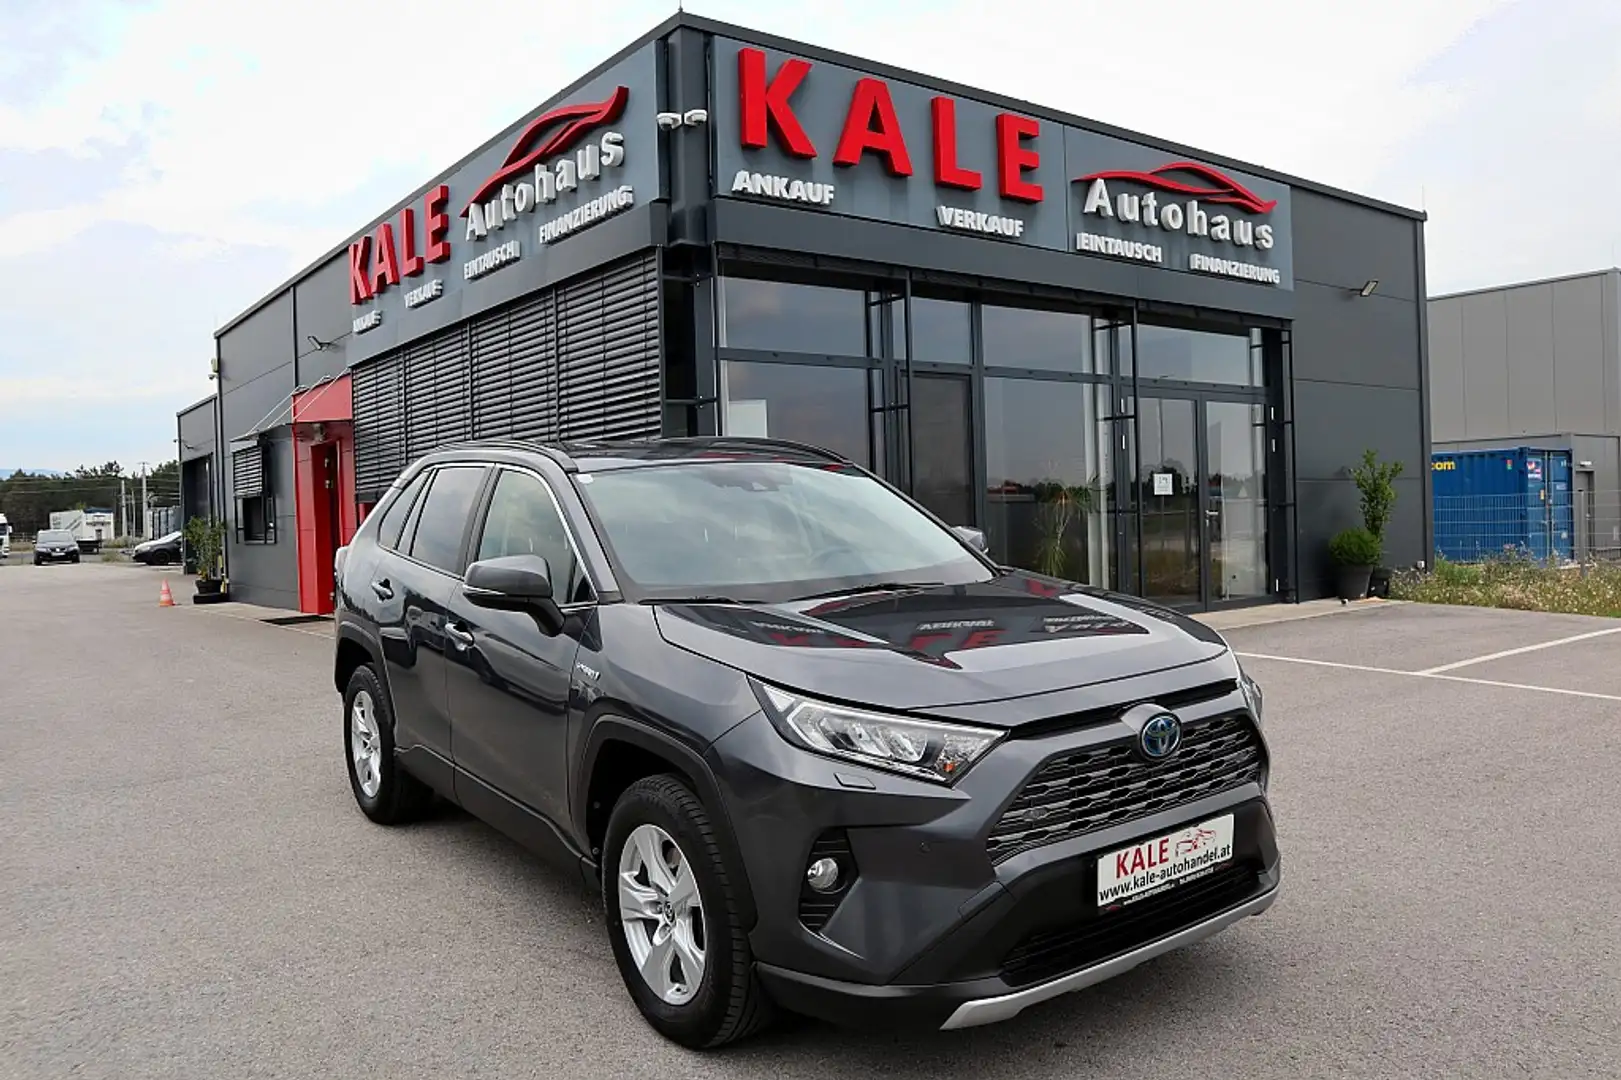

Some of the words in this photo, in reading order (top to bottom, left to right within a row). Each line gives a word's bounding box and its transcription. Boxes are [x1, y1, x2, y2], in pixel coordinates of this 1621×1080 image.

[737, 47, 1044, 203] KALE
[463, 239, 522, 281] EINTAUSCH
[539, 184, 635, 244] FINANZIERUNG
[465, 131, 625, 242] Autohaus
[731, 169, 836, 205] ANKAUF
[936, 205, 1024, 238] VERKAUF
[1076, 231, 1163, 263] EINTAUSCH
[1189, 253, 1281, 285] FINANZIERUNG
[1082, 178, 1275, 251] Autohaus
[348, 184, 451, 306] KALE
[1098, 843, 1231, 900] www.kale-autohandel.at
[1115, 838, 1170, 879] KALE
